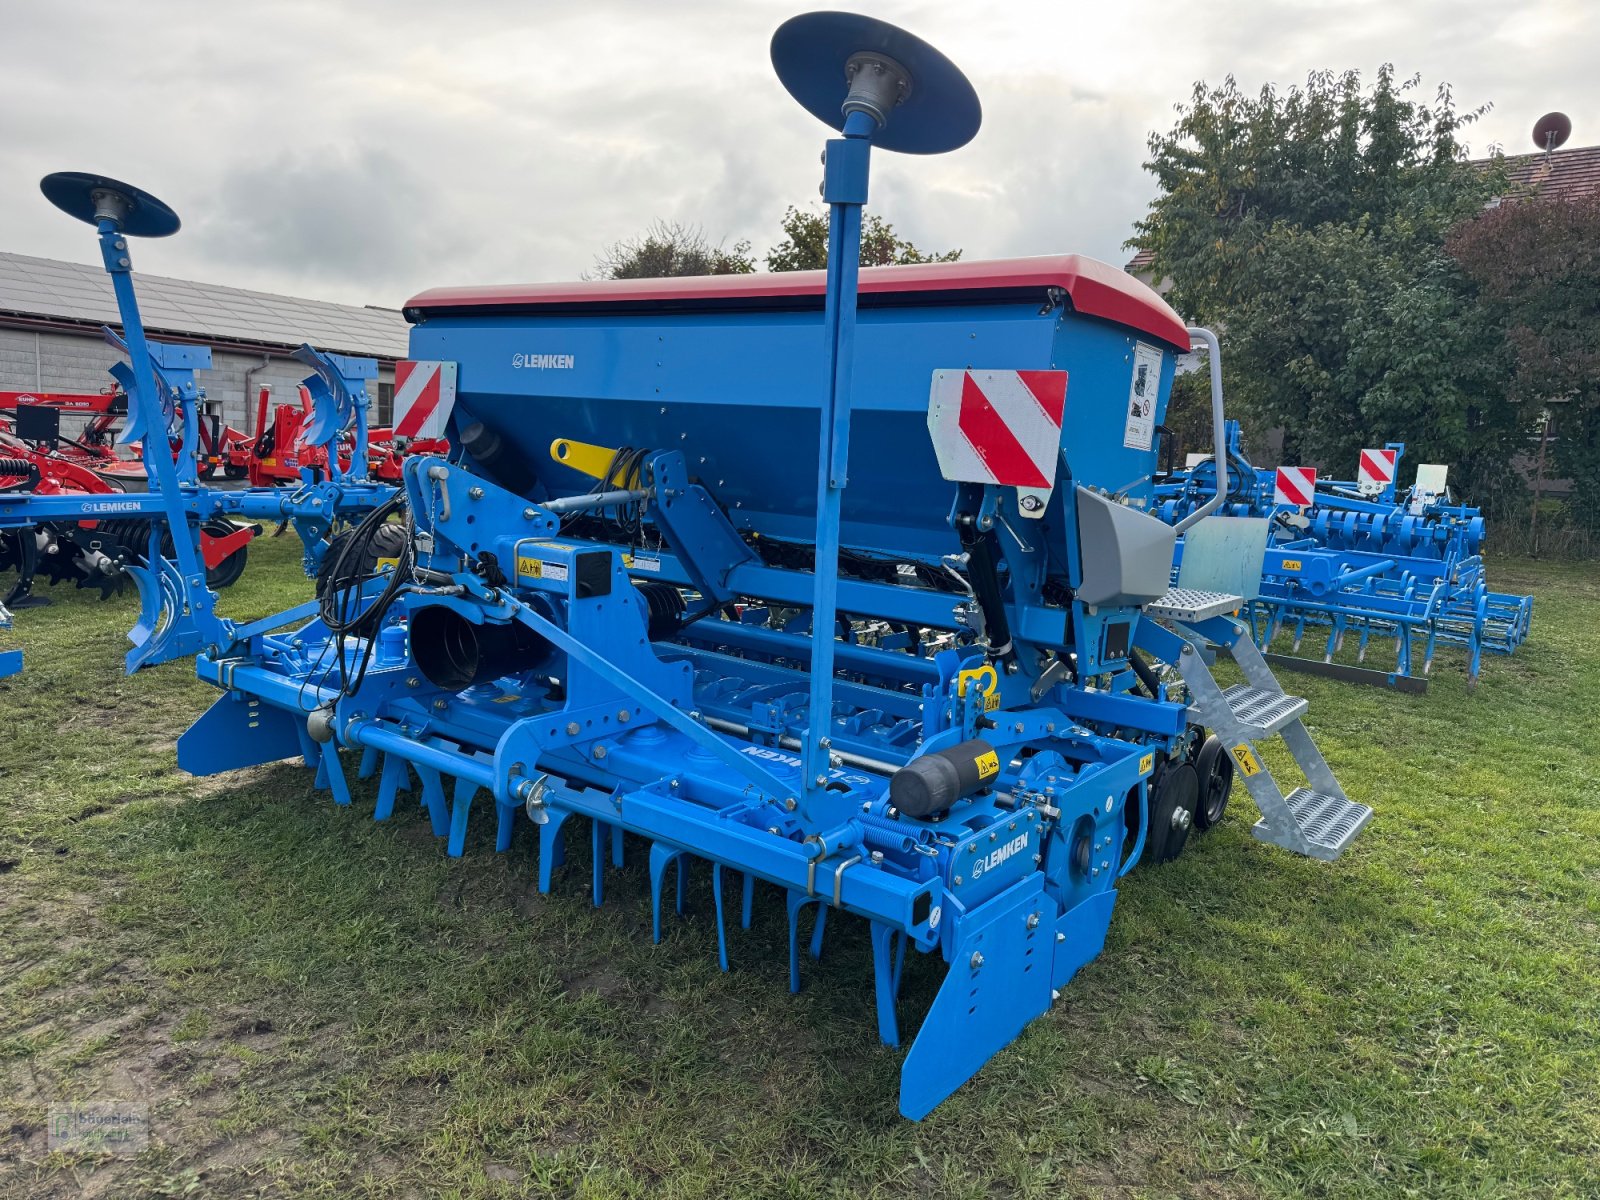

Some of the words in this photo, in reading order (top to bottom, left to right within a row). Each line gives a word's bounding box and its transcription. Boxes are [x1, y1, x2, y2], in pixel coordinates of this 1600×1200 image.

[524, 354, 575, 371] LEMKEN
[93, 502, 141, 512] LEMKEN
[984, 831, 1029, 873] LEMKEN
